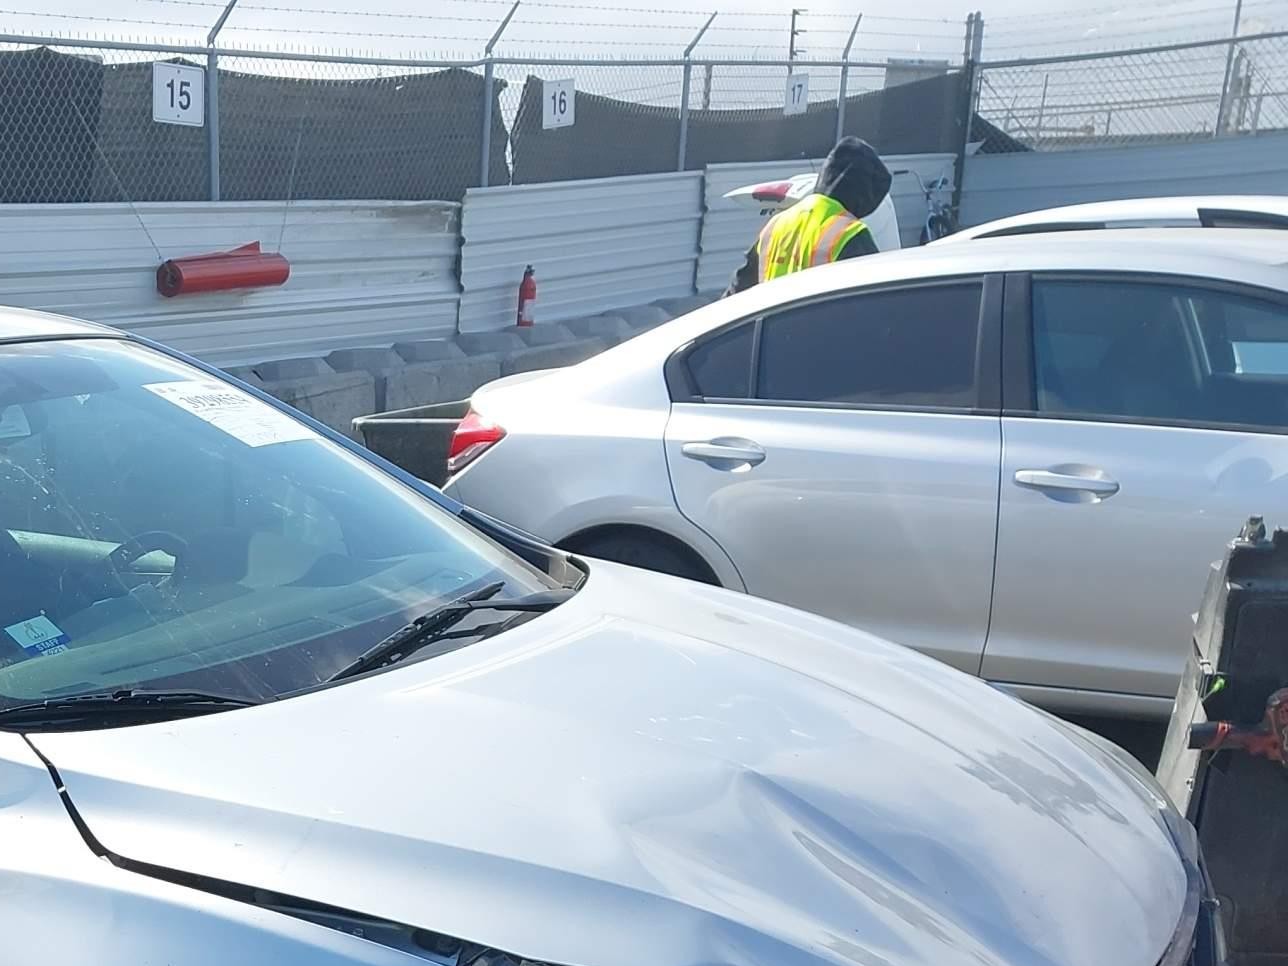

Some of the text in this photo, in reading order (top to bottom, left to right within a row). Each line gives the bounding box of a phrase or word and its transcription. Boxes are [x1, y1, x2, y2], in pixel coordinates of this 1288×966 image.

[166, 79, 191, 111] 15
[551, 90, 567, 116] 16
[792, 83, 803, 104] 17
[35, 638, 61, 652] STAFF
